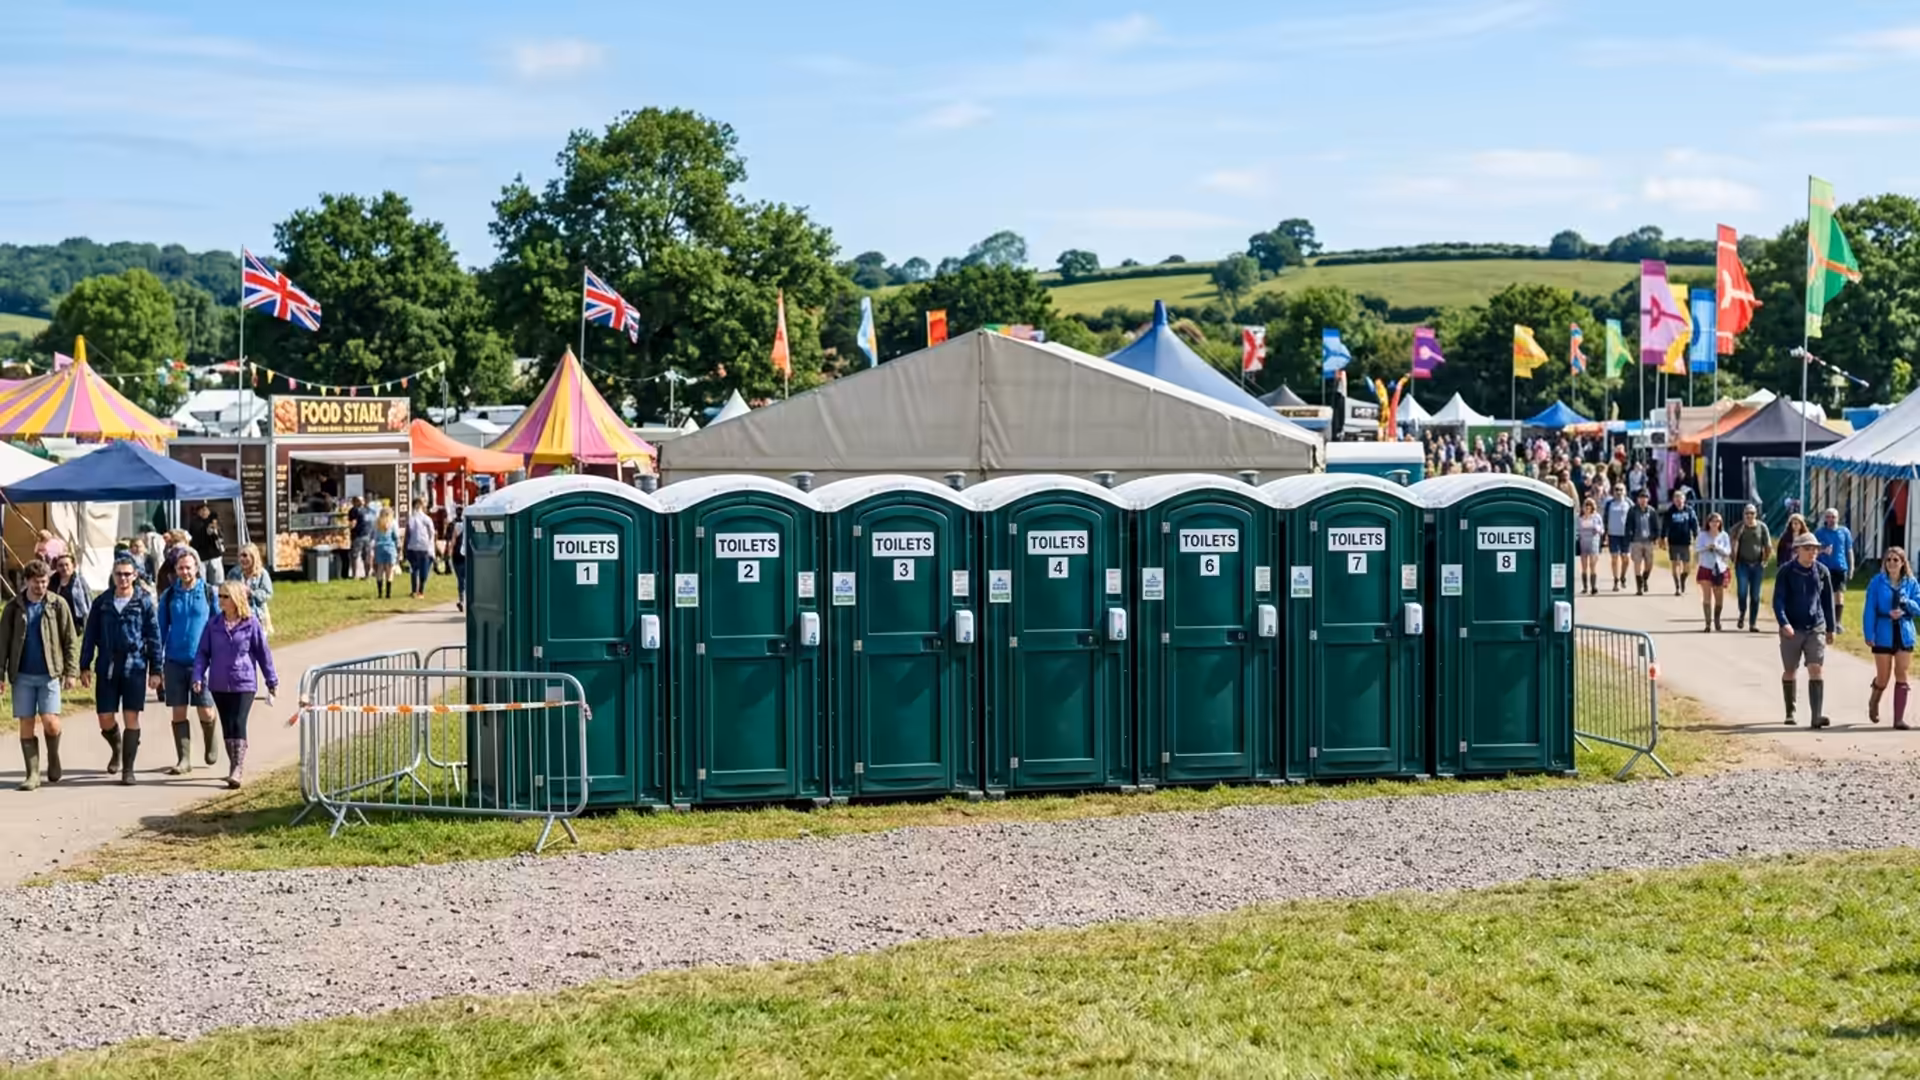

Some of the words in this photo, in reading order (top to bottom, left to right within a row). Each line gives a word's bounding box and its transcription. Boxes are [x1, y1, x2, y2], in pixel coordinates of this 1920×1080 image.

[300, 401, 341, 424] FOOD
[875, 537, 932, 551] TOILETS
[1030, 536, 1085, 550] TOILETS
[1182, 533, 1236, 547] TOILETS
[1330, 532, 1383, 546] TOILETS
[1479, 531, 1532, 545] TOILETS
[556, 541, 616, 554] TOILETS
[718, 539, 777, 553] TOILETS
[1053, 561, 1063, 574] 4
[1205, 559, 1215, 573] 6
[1353, 557, 1362, 571] 7
[1502, 555, 1511, 569] 8
[583, 566, 591, 581] 1
[743, 564, 754, 578] 2
[899, 563, 909, 577] 3
